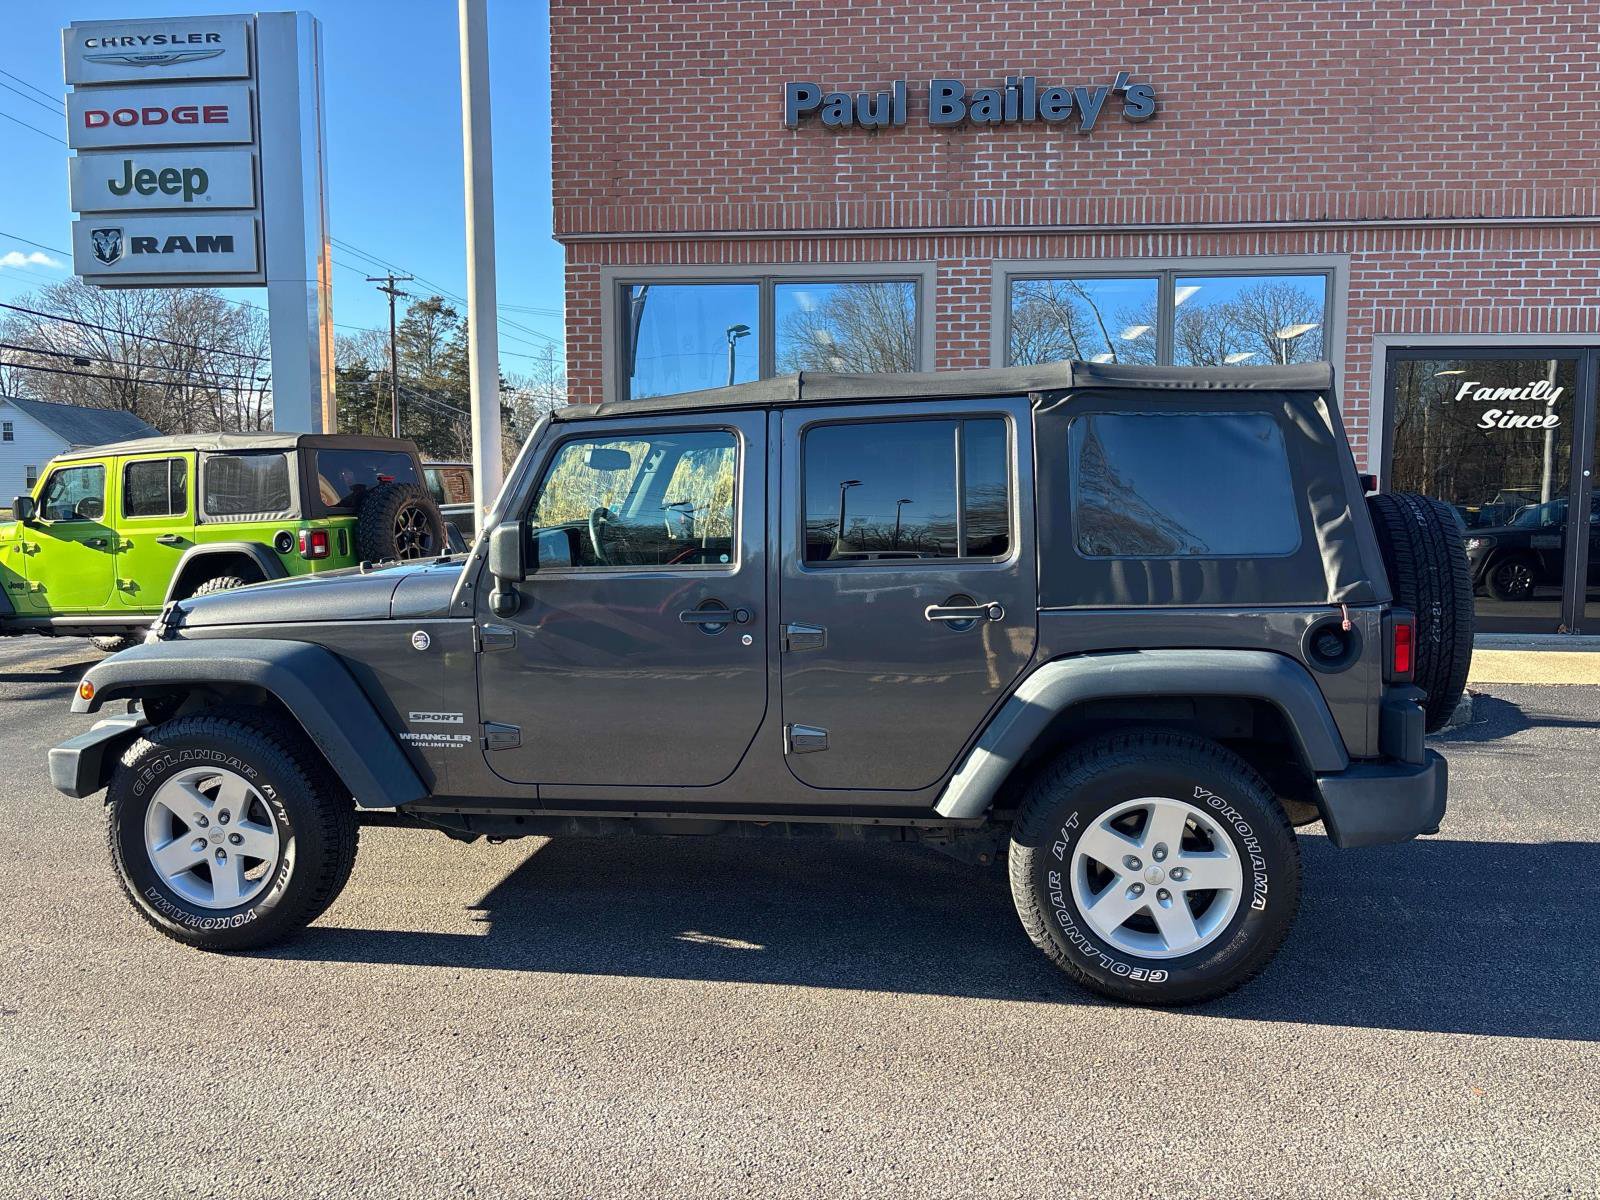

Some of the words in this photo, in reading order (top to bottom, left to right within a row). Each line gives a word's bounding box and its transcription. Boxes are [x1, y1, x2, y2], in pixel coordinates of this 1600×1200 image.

[84, 33, 222, 48] CHRYSLER
[84, 105, 229, 128] DODGE
[784, 80, 907, 129] Paul
[928, 71, 1156, 133] Bailey's
[107, 160, 209, 202] Jeep
[130, 235, 234, 254] RAM
[1455, 380, 1564, 406] Family
[1477, 409, 1562, 429] Since
[410, 713, 462, 721] SPORT
[399, 732, 472, 743] WRANGLER
[132, 749, 258, 796] GEOLANDAR
[261, 784, 290, 826] A/T
[1052, 812, 1080, 861] A/T
[1192, 786, 1268, 911] YOKOHAMA
[144, 886, 258, 930] YOKOHAMA
[1048, 871, 1168, 983] GEOLANDAR
